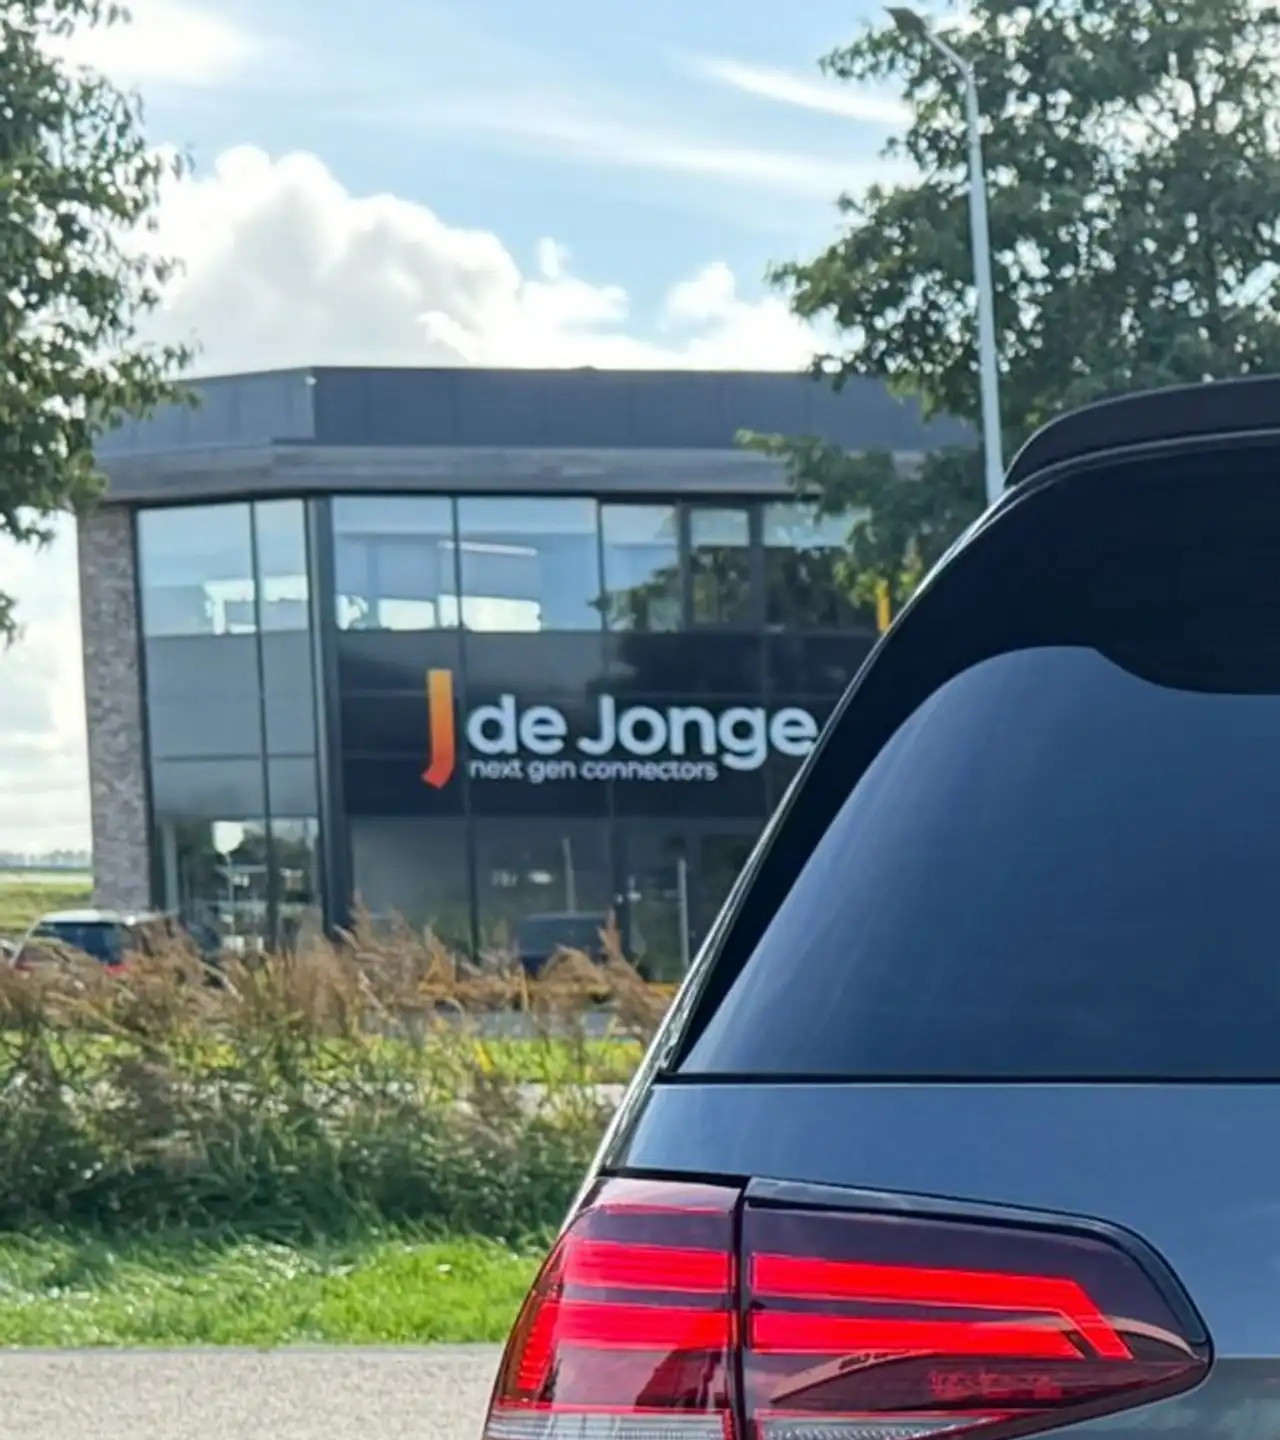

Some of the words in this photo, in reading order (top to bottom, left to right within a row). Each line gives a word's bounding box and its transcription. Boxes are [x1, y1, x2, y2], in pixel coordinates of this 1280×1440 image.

[466, 693, 568, 755] de
[576, 693, 819, 771] Jonge
[469, 759, 524, 779] next
[528, 761, 577, 784] gen
[581, 758, 718, 781] connectors
